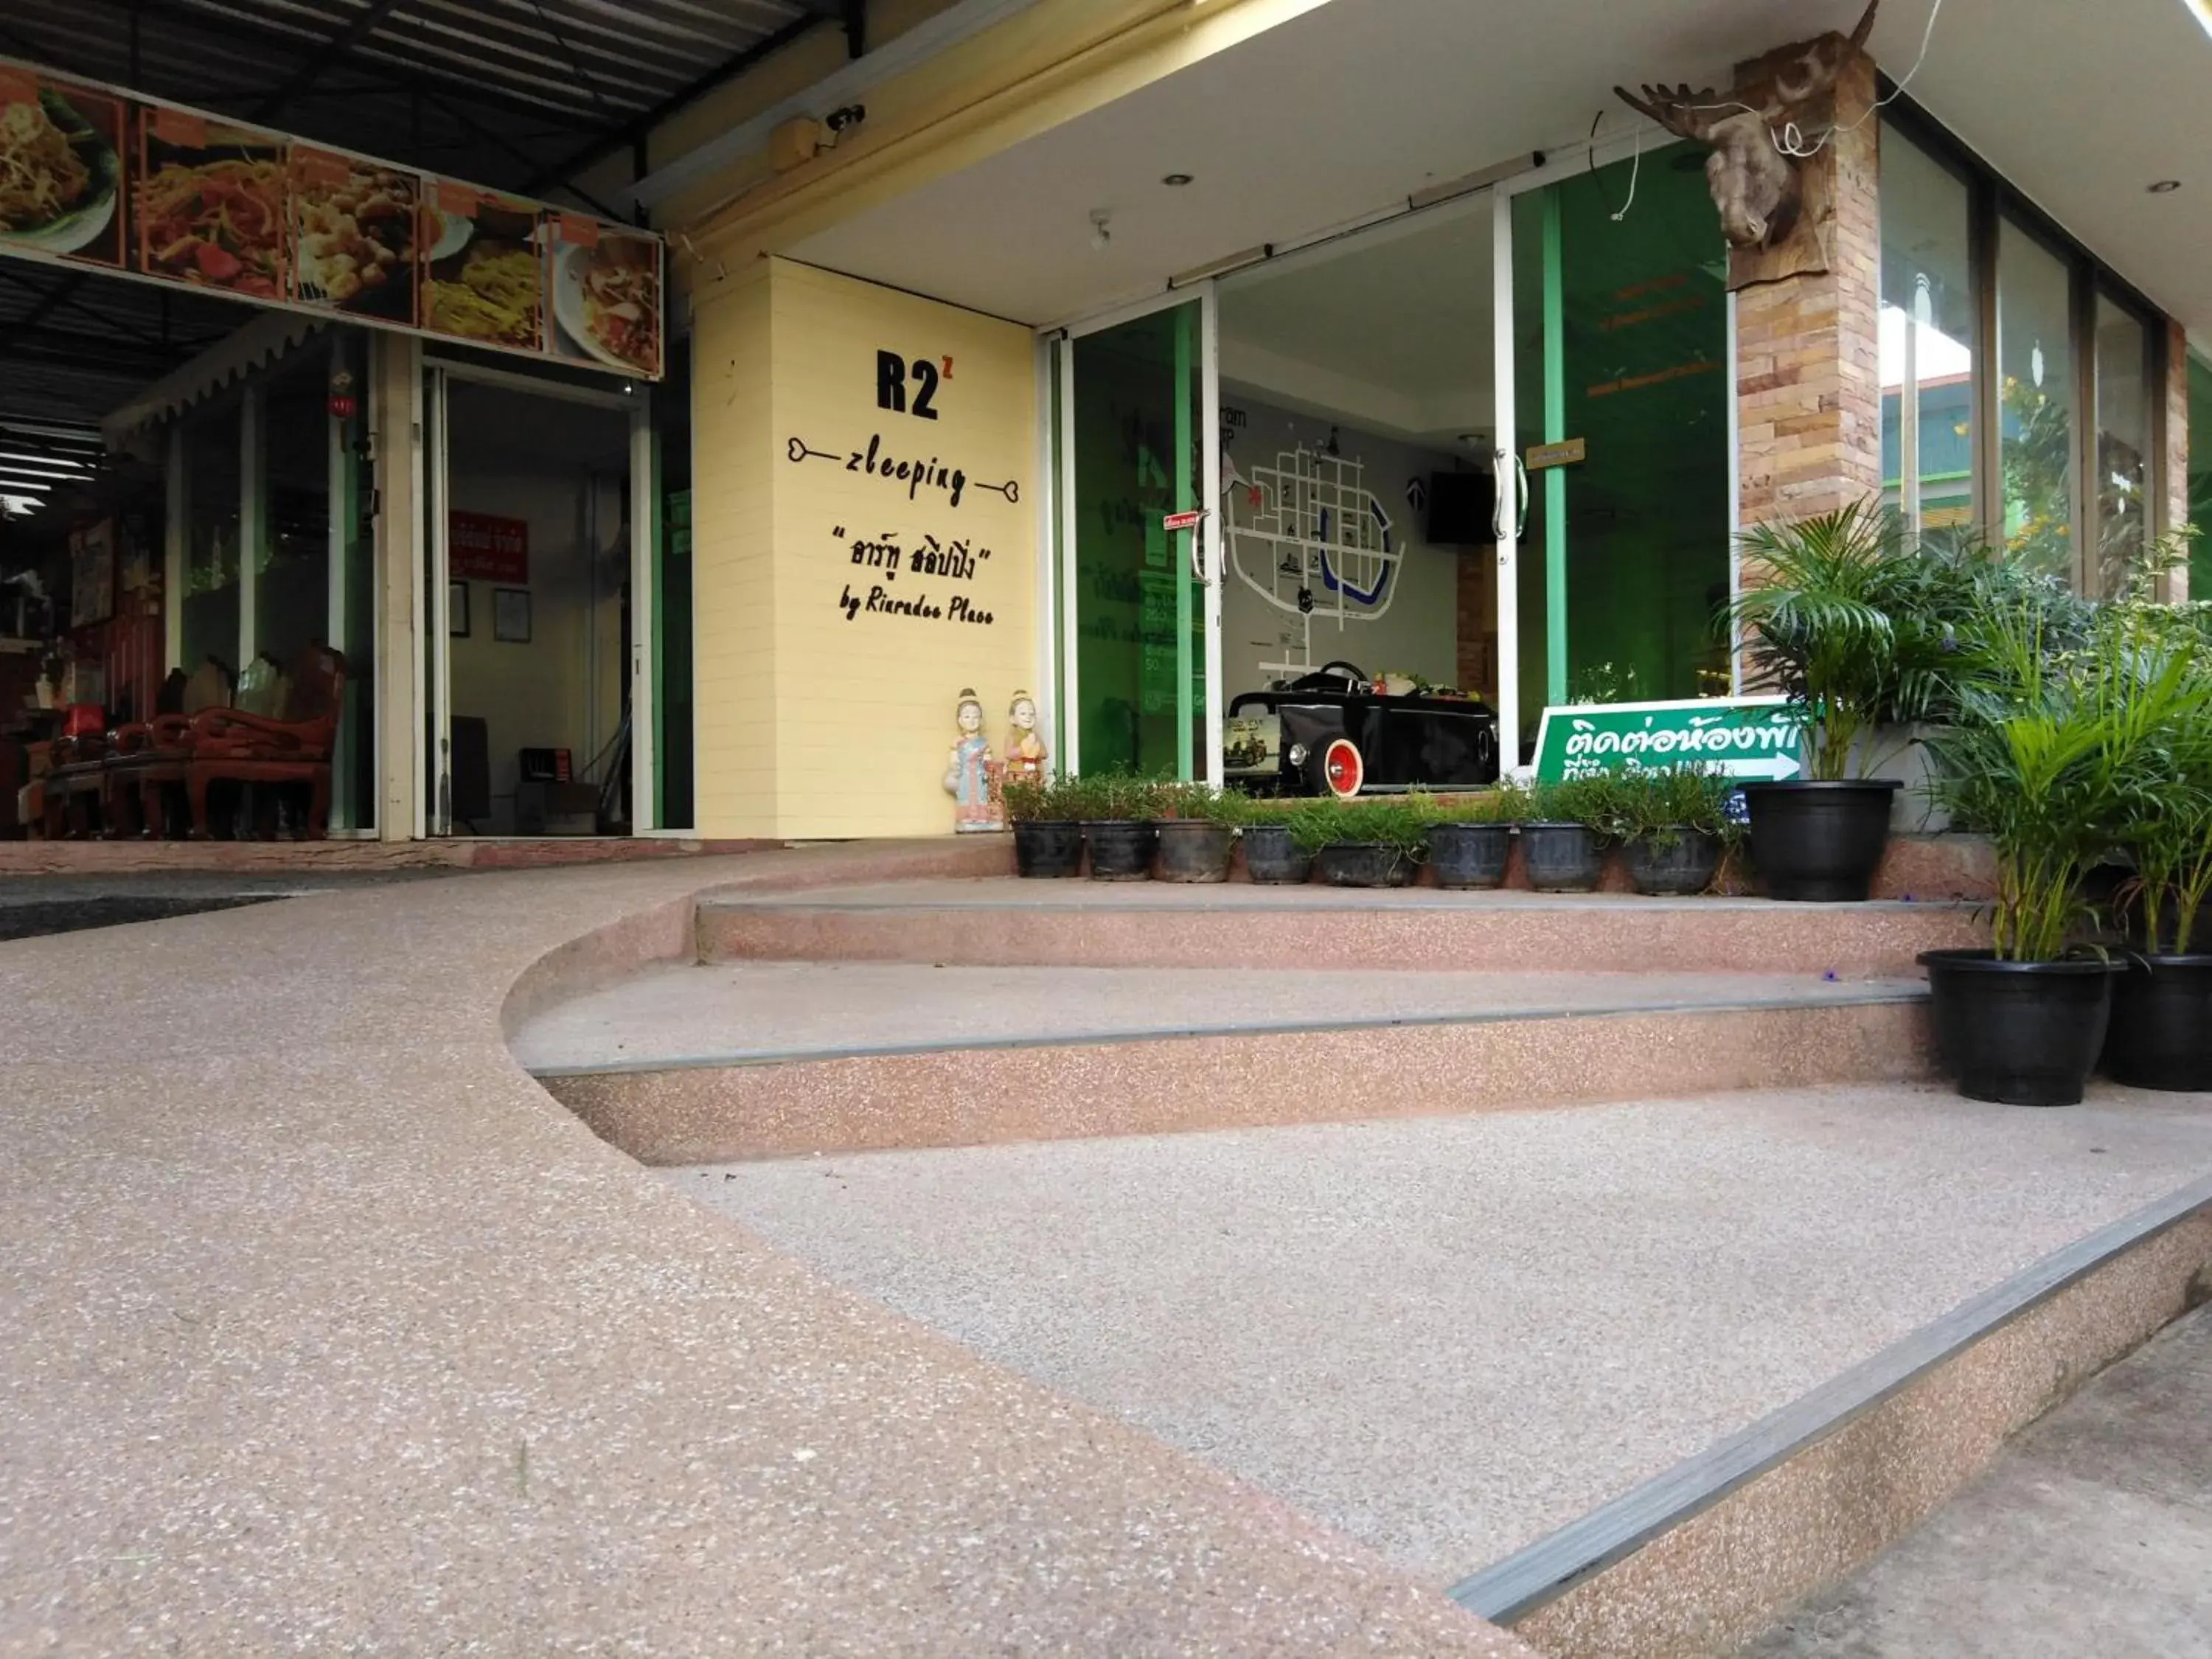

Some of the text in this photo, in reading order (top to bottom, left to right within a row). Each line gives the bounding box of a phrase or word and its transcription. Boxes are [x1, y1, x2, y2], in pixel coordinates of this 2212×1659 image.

[846, 434, 965, 507] zleeping
[839, 585, 861, 620] by
[948, 597, 994, 625] Place
